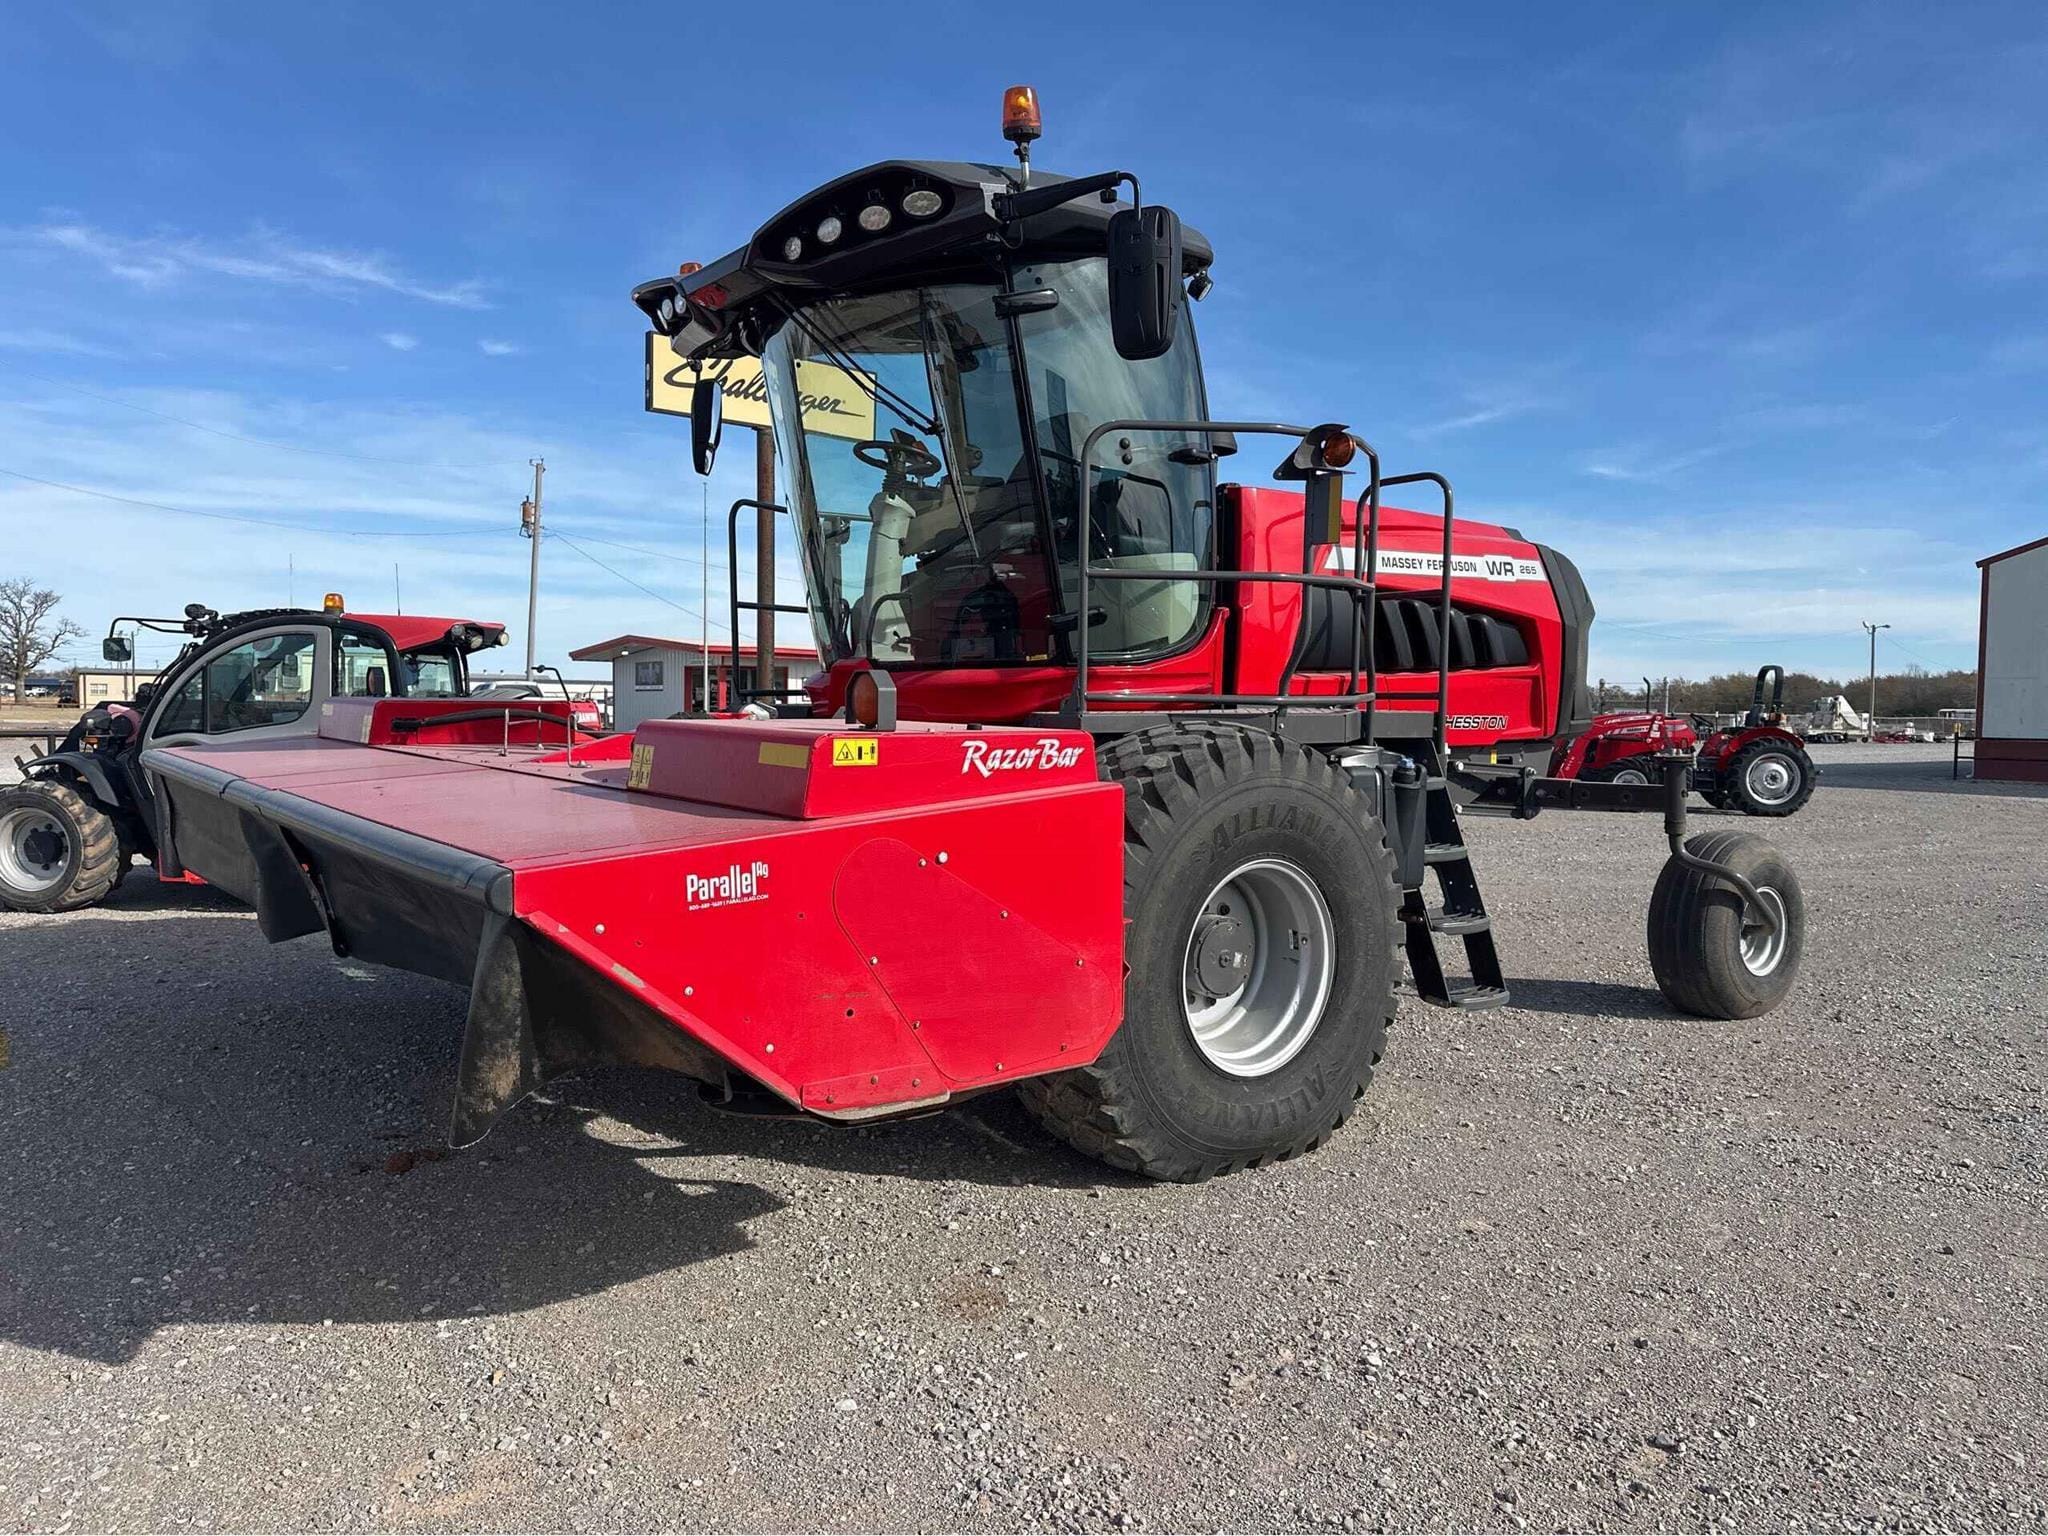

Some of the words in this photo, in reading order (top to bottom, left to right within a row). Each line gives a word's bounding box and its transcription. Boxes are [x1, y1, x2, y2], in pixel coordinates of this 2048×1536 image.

[1381, 556, 1423, 570] MASSEY
[1426, 559, 1477, 572] FERUSON
[1485, 560, 1515, 577] WR
[1519, 565, 1537, 575] 265
[1445, 715, 1508, 729] HESSTON
